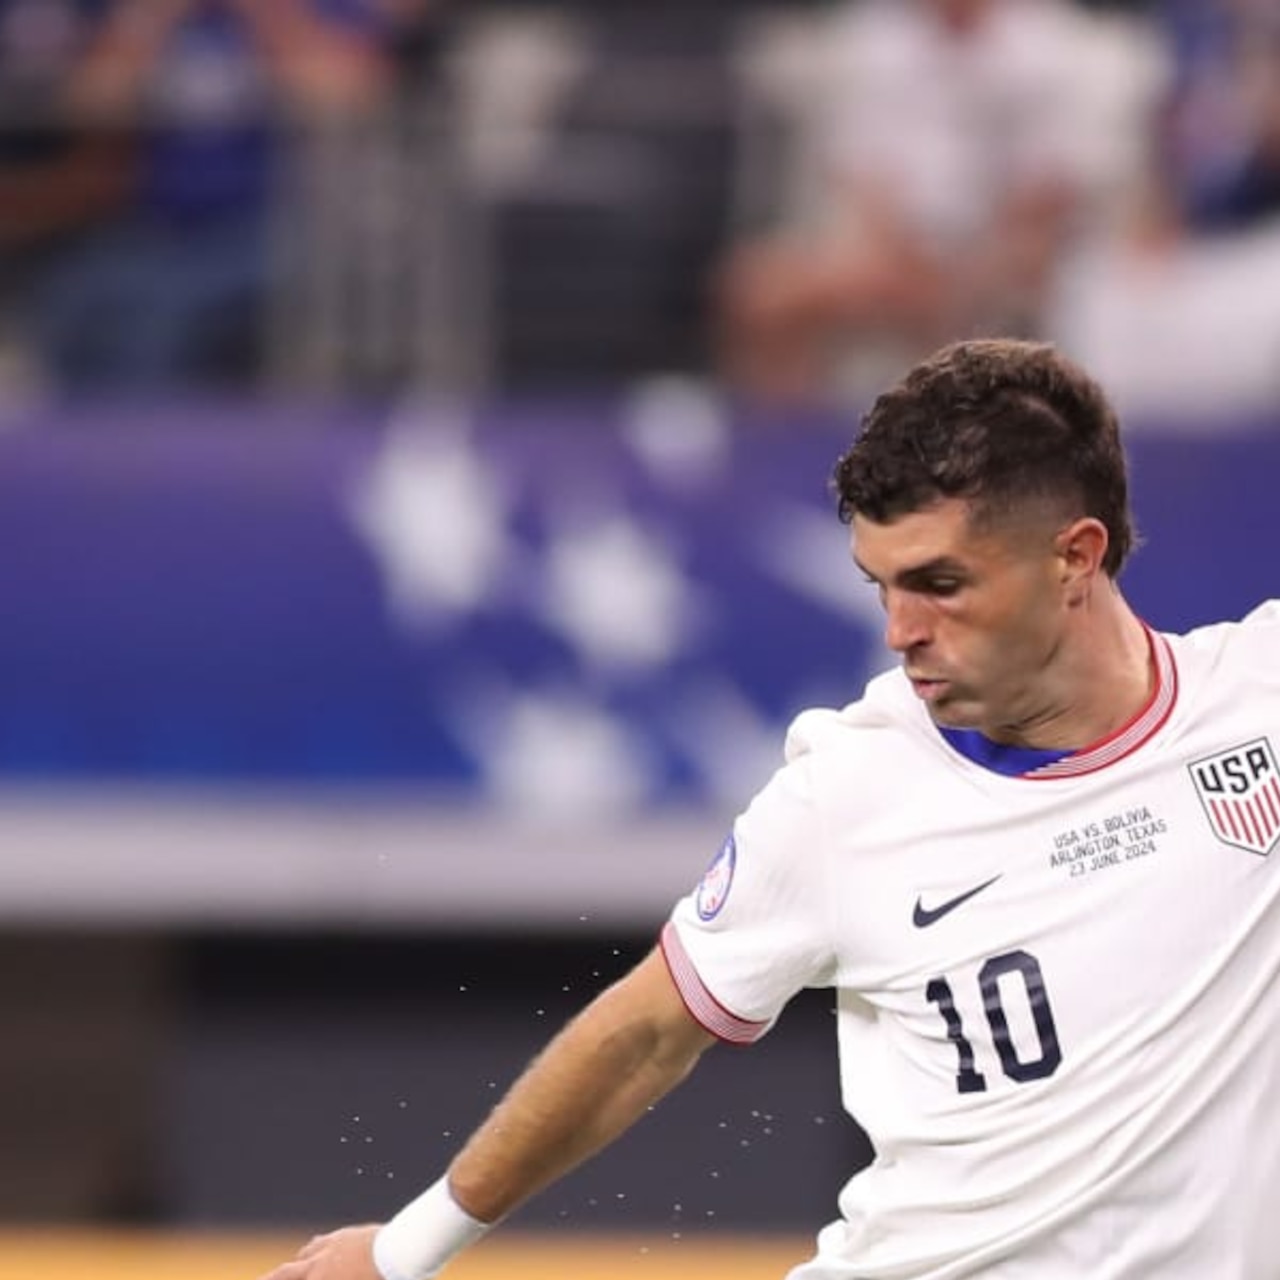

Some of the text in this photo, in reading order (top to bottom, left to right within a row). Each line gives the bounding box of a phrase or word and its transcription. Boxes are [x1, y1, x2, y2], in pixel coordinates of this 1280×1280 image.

[1197, 746, 1270, 794] USA
[1053, 829, 1080, 850] USA
[1103, 806, 1153, 833] BOLIVIA
[1125, 818, 1168, 843] TEXAS
[1069, 839, 1157, 878] 23 JUNE 2024
[926, 949, 1063, 1094] 10
